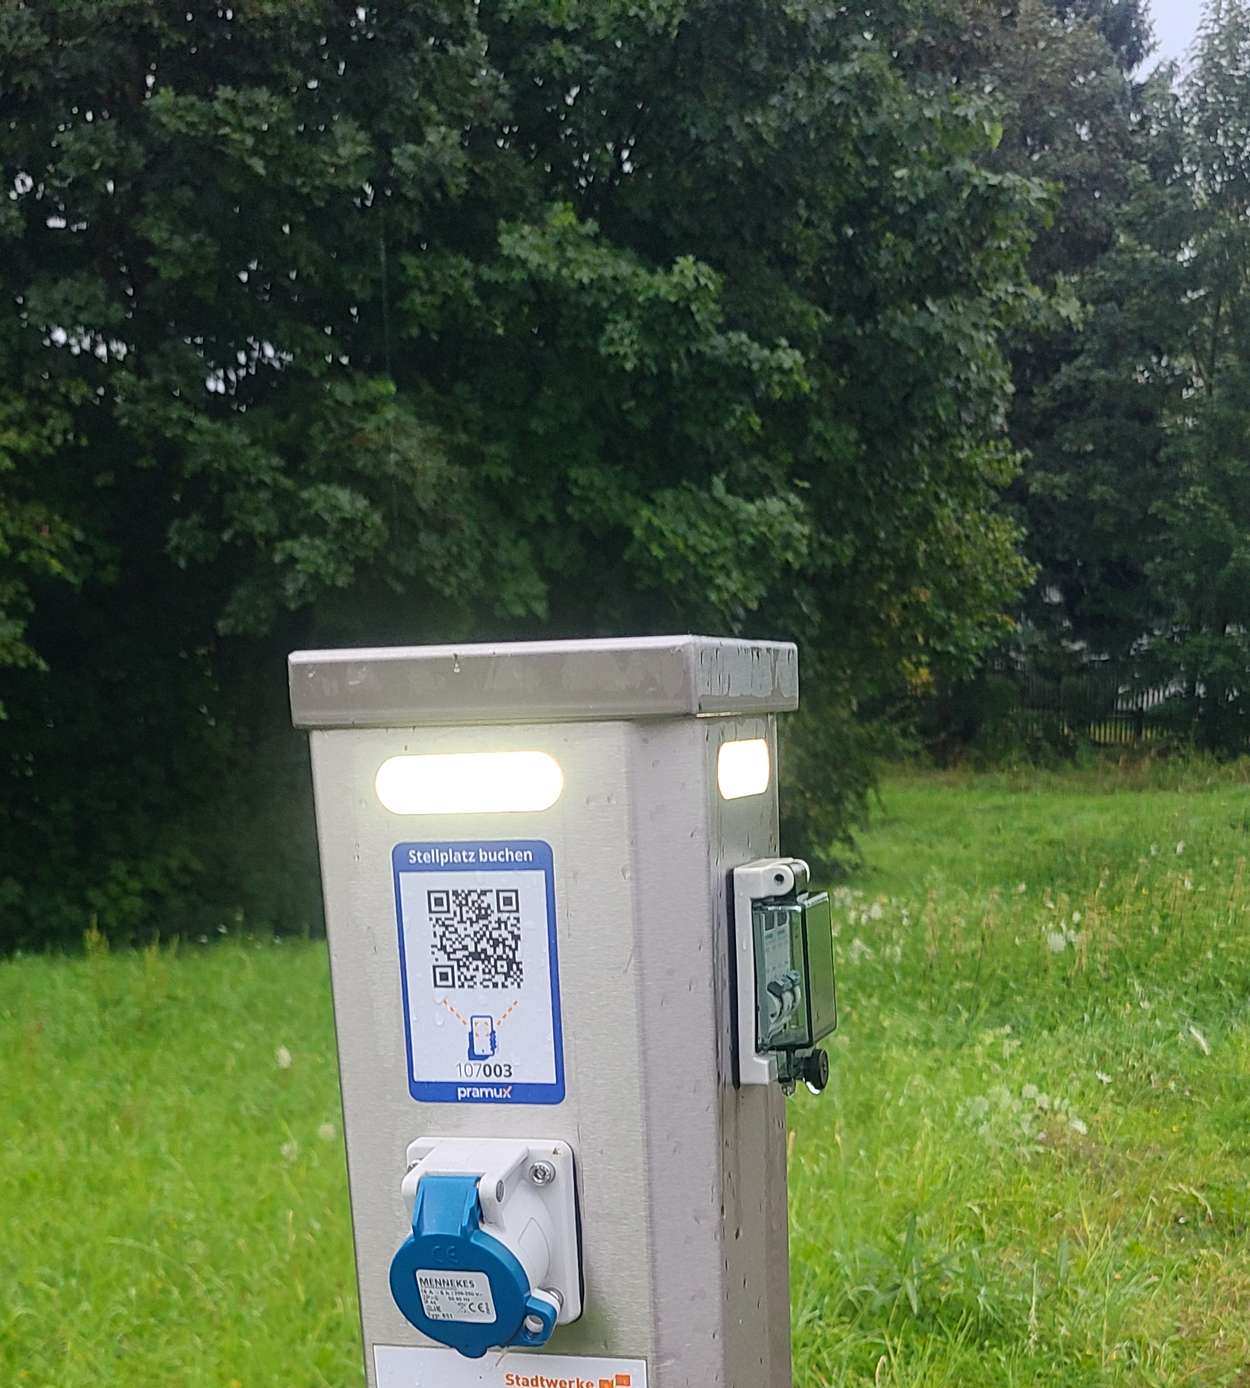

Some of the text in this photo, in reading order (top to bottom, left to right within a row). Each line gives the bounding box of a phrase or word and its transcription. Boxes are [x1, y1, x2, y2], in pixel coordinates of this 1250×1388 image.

[408, 848, 533, 867] Stellplatz buchen
[456, 1063, 513, 1078] 107003
[457, 1086, 512, 1101] pramux
[419, 1277, 475, 1288] MENNEKES
